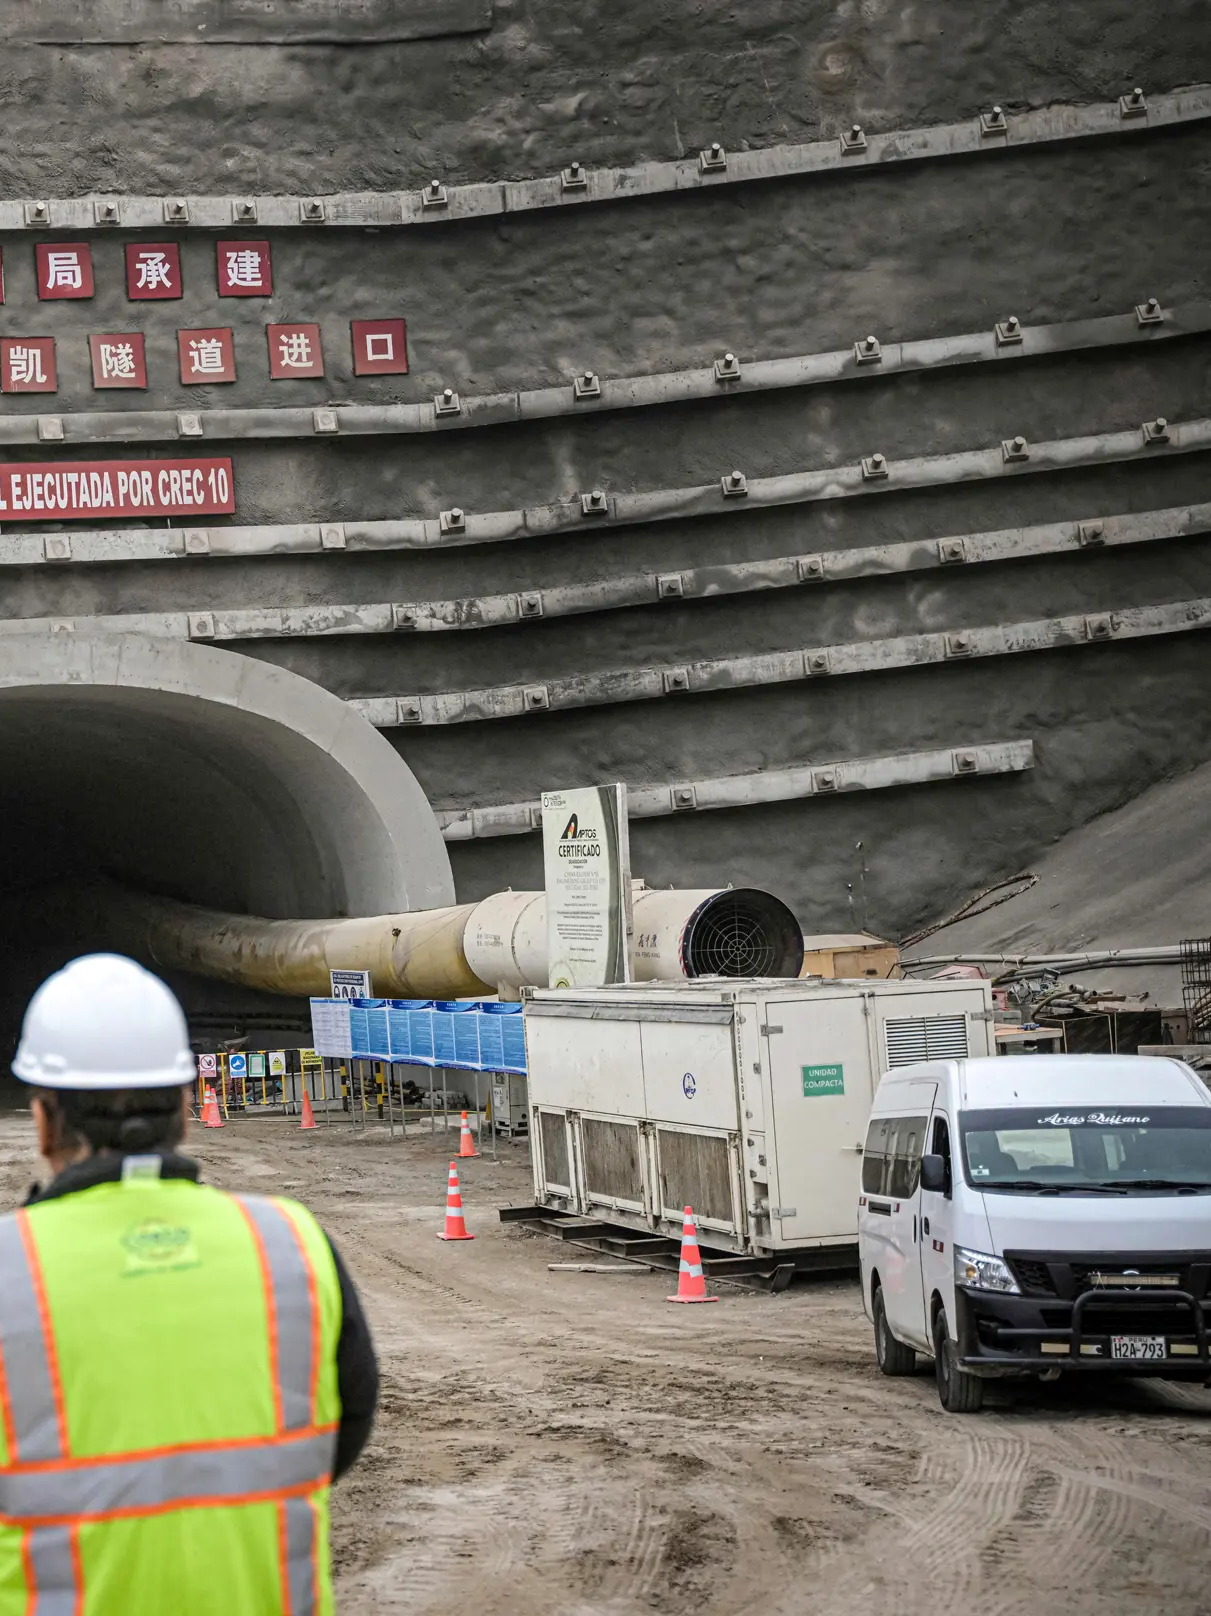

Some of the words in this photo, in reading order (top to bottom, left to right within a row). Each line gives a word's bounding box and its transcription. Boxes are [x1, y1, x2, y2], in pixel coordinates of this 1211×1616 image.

[12, 471, 115, 511] EJECUTADA
[117, 470, 155, 507] POR
[158, 468, 205, 505] CREC
[208, 467, 229, 504] 10
[558, 844, 601, 857] CERTIFICADO
[808, 1068, 837, 1077] UNIDAD
[804, 1080, 843, 1089] COMPACTA
[1037, 1112, 1085, 1126] Arias
[1114, 1343, 1164, 1358] H2A-793
